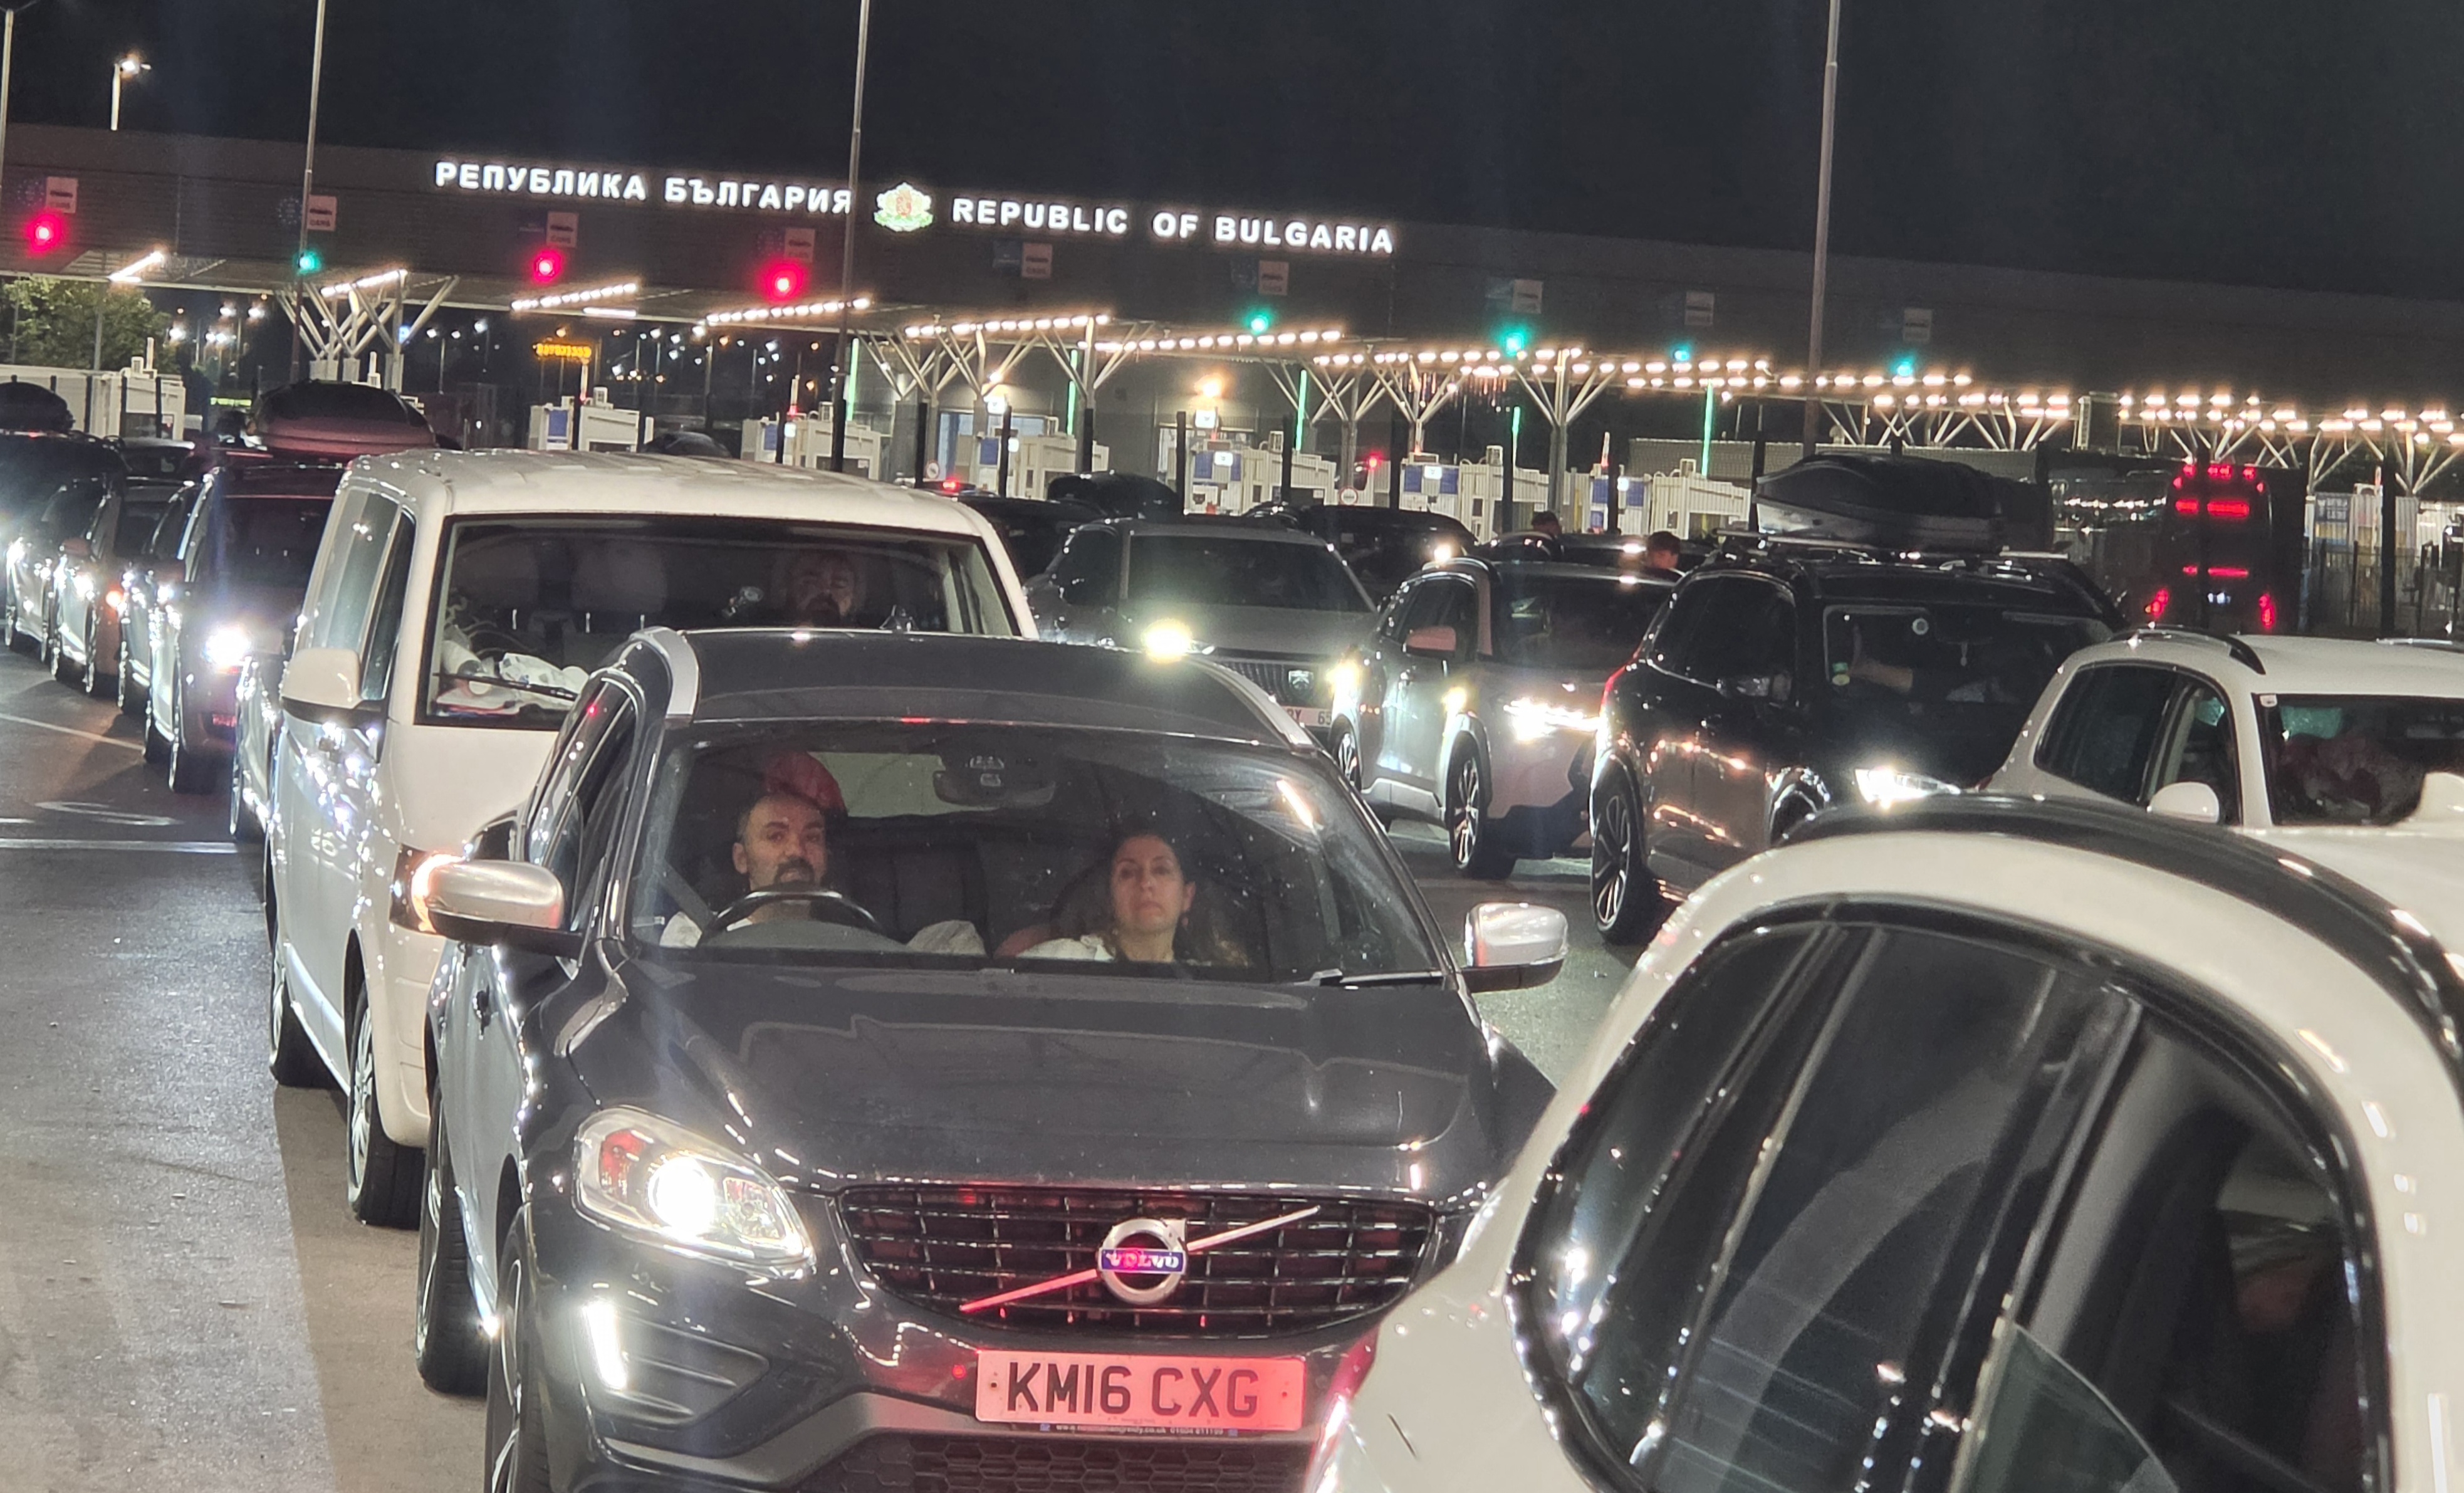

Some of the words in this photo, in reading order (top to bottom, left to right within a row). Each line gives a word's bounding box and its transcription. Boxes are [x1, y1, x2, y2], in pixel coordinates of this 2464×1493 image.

[436, 162, 646, 201] РЕПУБЛИКА
[664, 177, 852, 214] БЪЛГАРИЯ
[952, 197, 1127, 234] REPUBLIC
[1152, 212, 1198, 239] OF
[1214, 216, 1393, 254] BULGARIA
[1105, 1251, 1179, 1269] VOLVO
[1007, 1361, 1132, 1415] KM16
[1151, 1366, 1259, 1418] CXG
